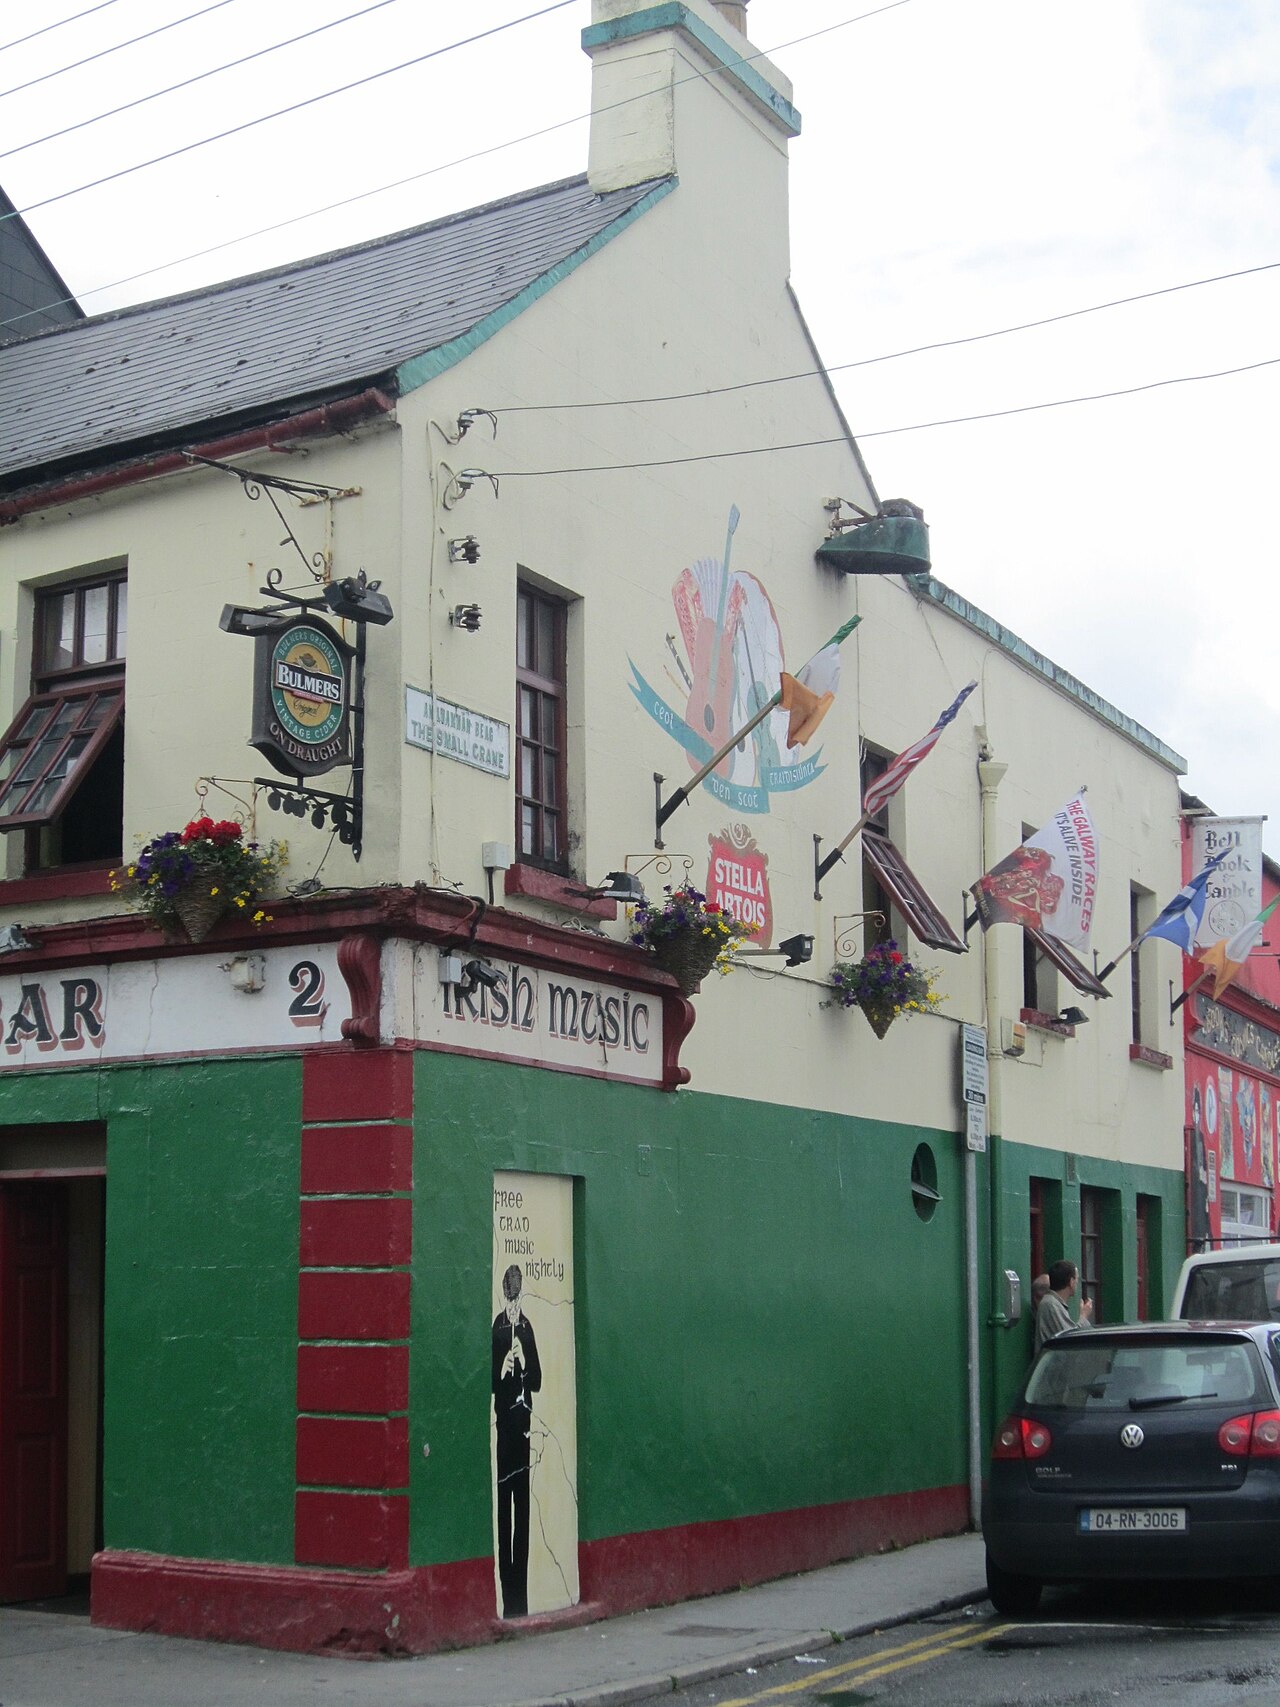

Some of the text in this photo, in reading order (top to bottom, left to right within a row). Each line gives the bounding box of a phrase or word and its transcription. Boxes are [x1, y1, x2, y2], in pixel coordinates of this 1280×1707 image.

[279, 631, 339, 671] BULMERS ORIGINAL
[278, 664, 340, 700] BULMERS
[276, 699, 338, 740] VINTAGE CIDER
[269, 722, 343, 762] ON DRAUGHT
[411, 720, 504, 769] THE SMALL CRANE
[1055, 812, 1083, 907] IT'S ALIVE INSIDE
[1204, 830, 1243, 852] Bell
[715, 857, 765, 897] STELLA
[1066, 799, 1096, 933] THE GALWAY RACES
[716, 889, 766, 928] ARTOIS
[0, 960, 325, 1052] AR 2
[525, 1258, 564, 1282] nightly
[1095, 1513, 1178, 1529] 04-RN-3006
